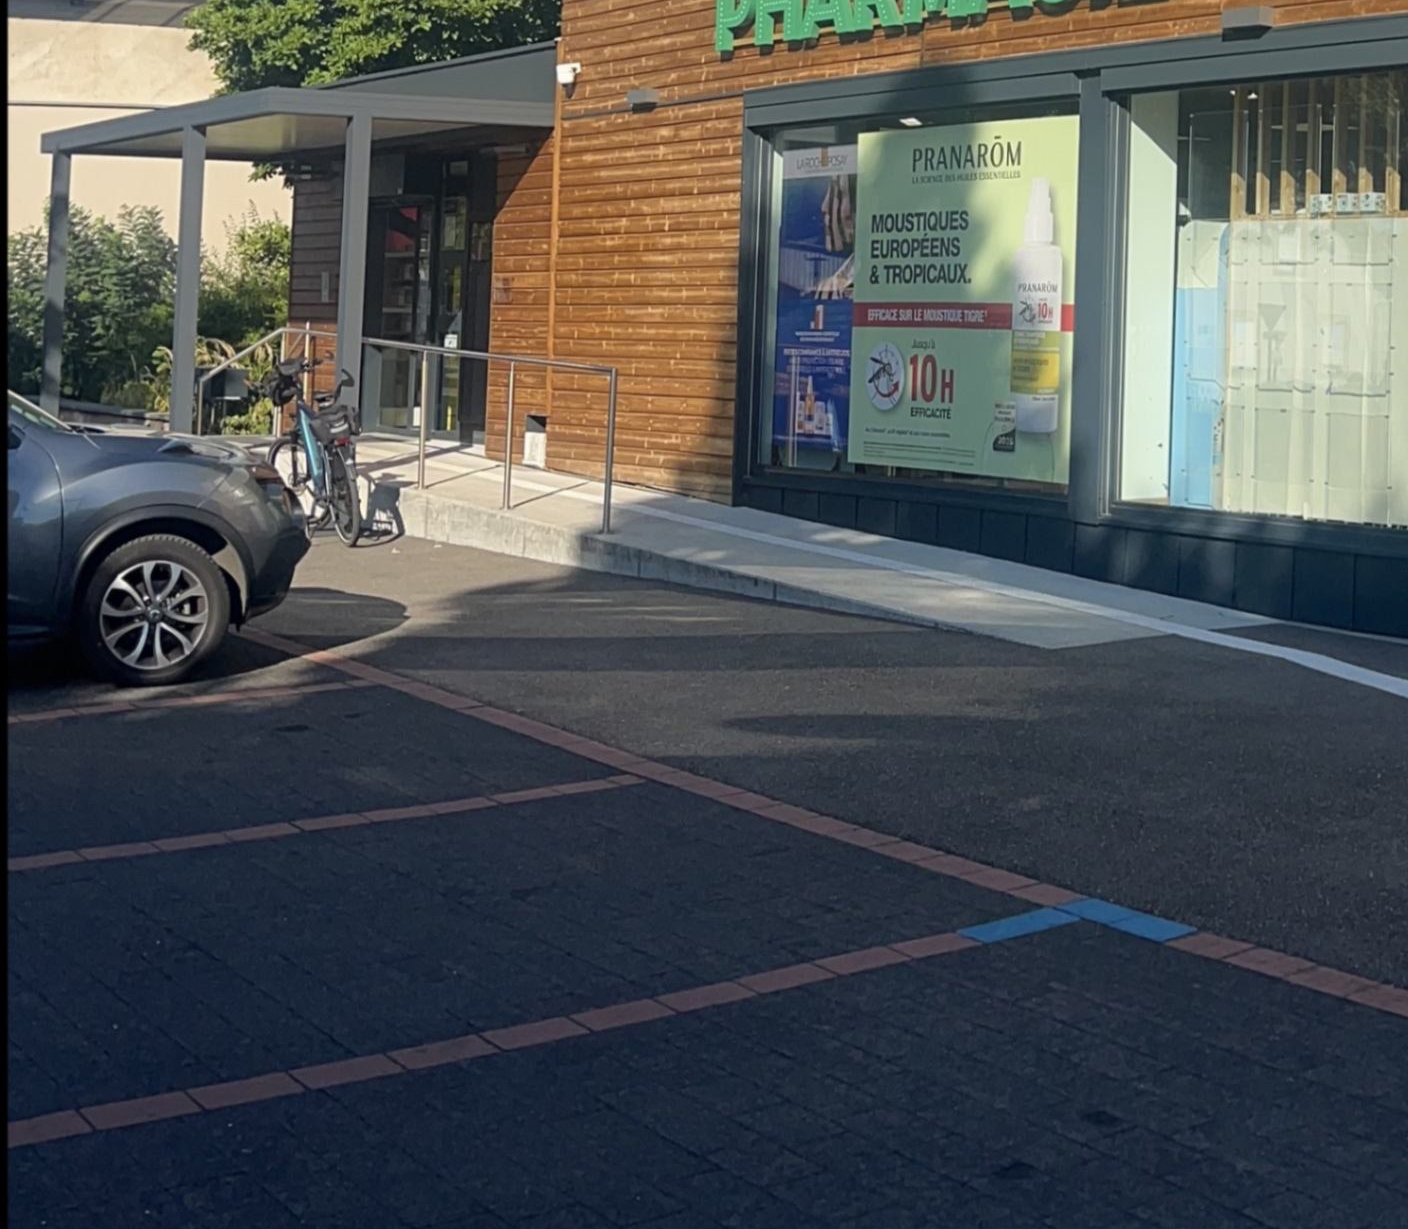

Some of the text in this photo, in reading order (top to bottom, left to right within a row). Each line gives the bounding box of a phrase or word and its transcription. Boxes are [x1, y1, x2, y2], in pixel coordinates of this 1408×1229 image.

[871, 210, 969, 233] MOUSTIQUES
[870, 233, 961, 259] EUROPÉENS
[869, 263, 972, 285] & TROPICAUX.
[867, 308, 898, 321] EFFICACE
[899, 309, 913, 322] SUR
[914, 309, 922, 322] LE
[923, 308, 962, 323] MOUSTIQUE
[910, 406, 952, 420] EFFICACITÉ
